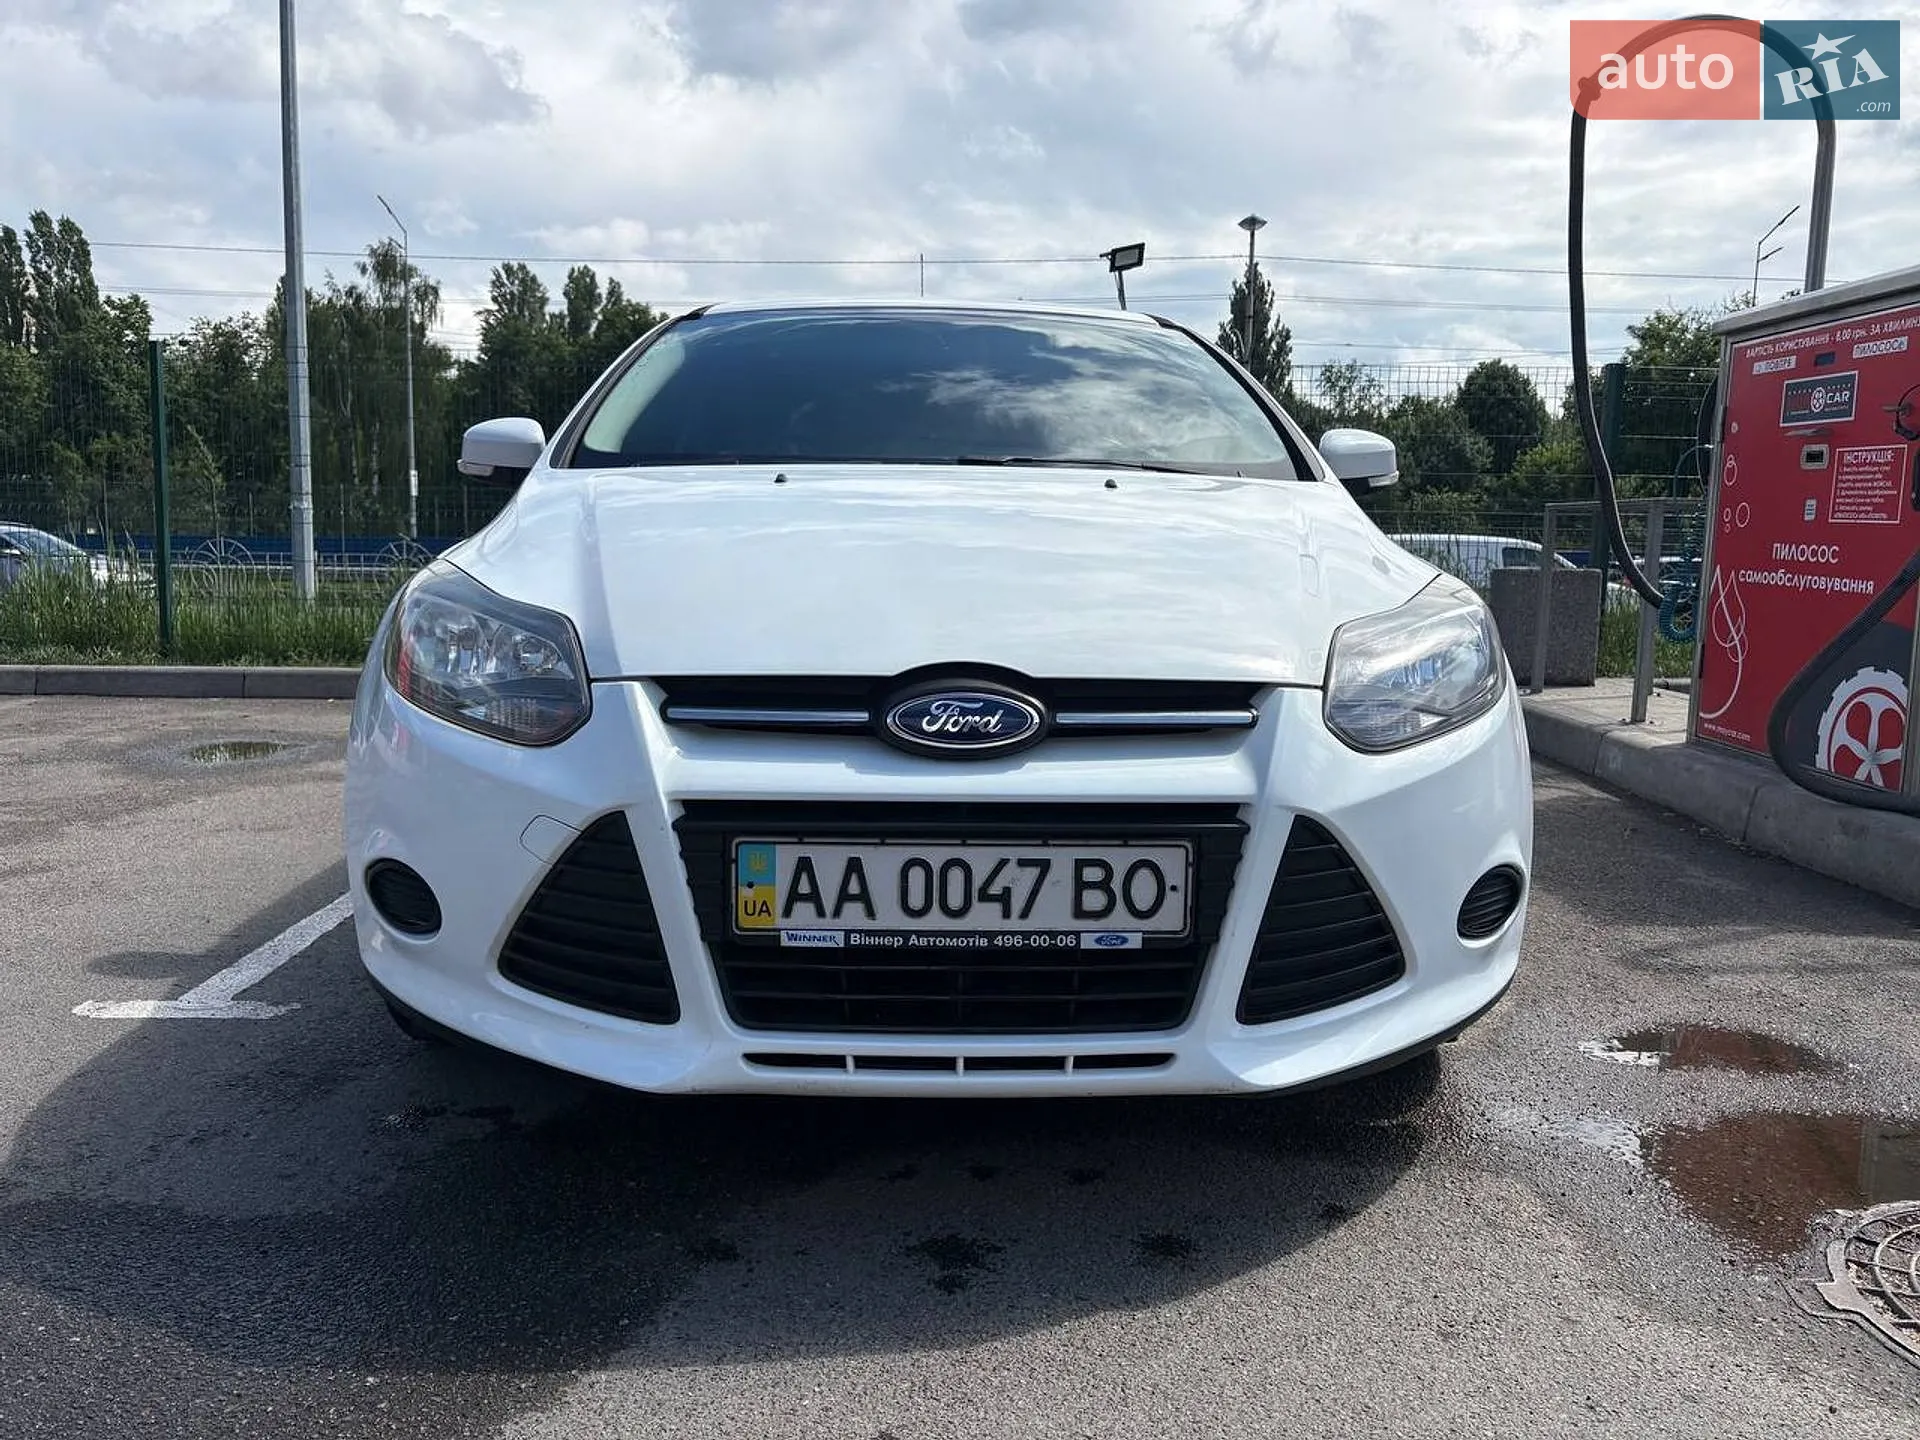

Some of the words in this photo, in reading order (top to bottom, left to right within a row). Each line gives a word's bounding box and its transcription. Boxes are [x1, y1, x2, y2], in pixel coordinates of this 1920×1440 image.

[1772, 543, 1840, 564] ПИЛОСОС
[1738, 569, 1875, 595] самообслуговування
[922, 700, 1004, 733] Ford
[899, 857, 1052, 919] 0047
[743, 899, 772, 918] UA
[850, 933, 903, 948] Віннер
[908, 934, 989, 947] Автомотів
[993, 934, 1077, 947] 496-00-06
